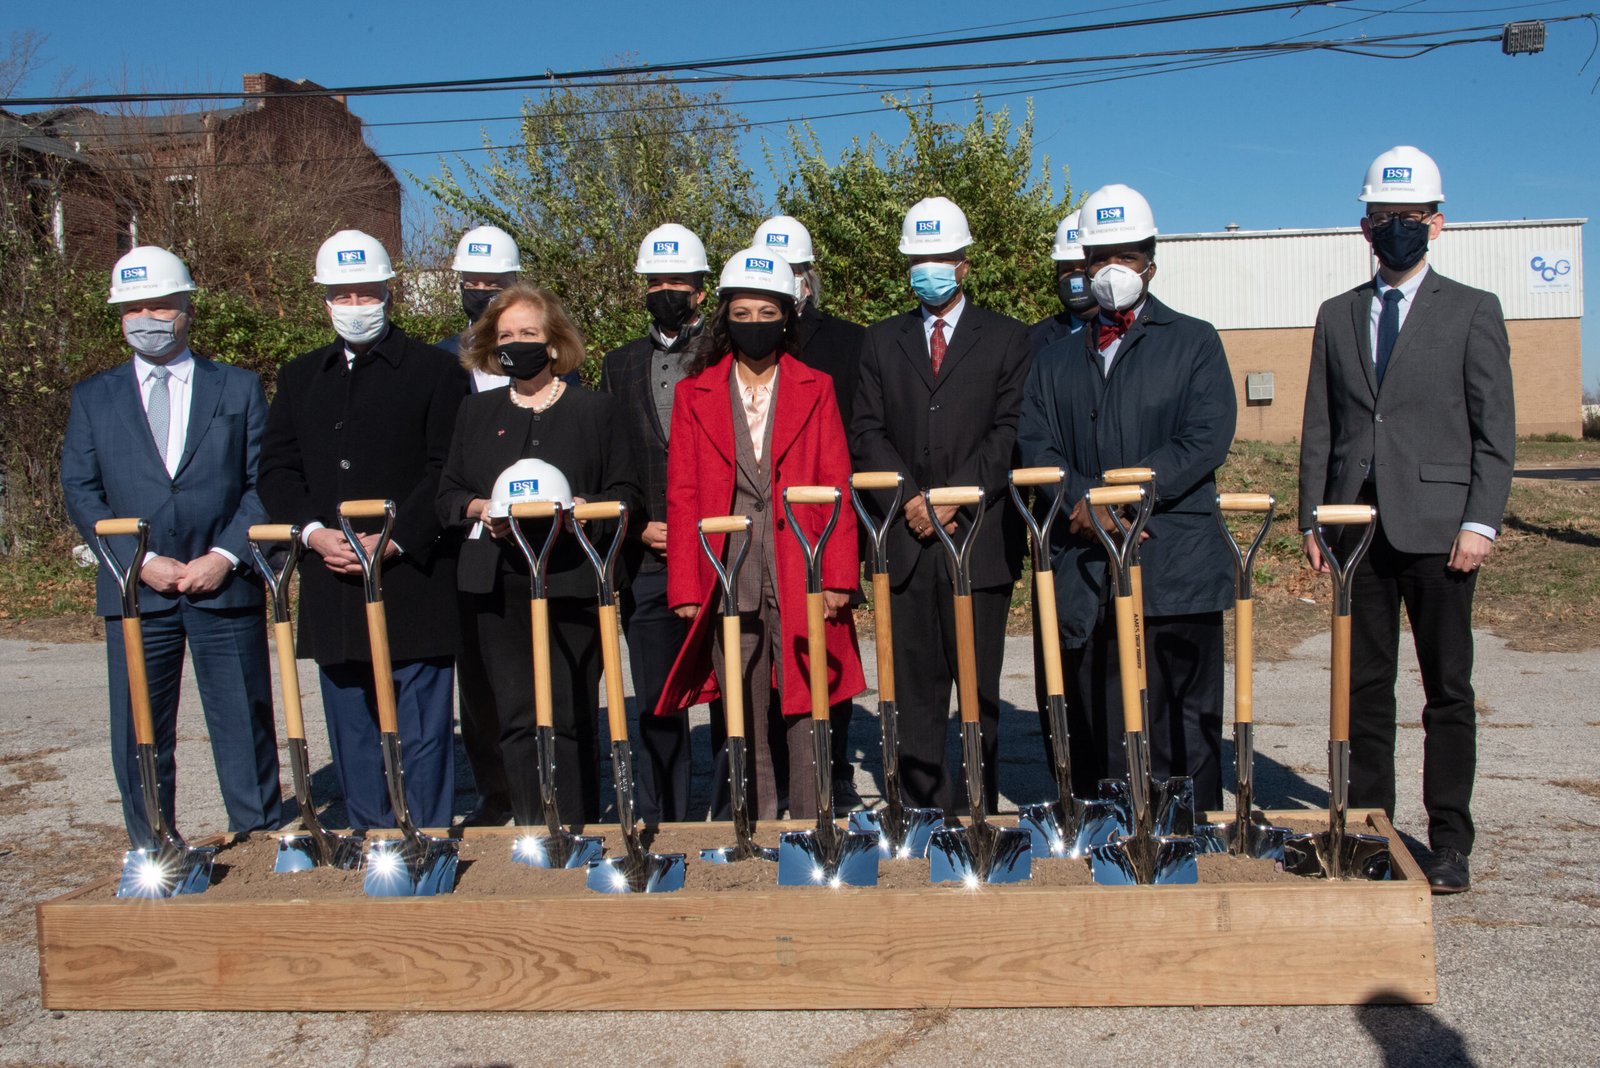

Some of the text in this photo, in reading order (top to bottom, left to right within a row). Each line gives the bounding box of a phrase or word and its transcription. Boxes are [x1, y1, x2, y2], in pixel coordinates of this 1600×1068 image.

[1386, 169, 1409, 178] BSI
[1100, 208, 1121, 219] BSI
[919, 222, 937, 231] BSI
[769, 235, 786, 243] BSI
[471, 244, 488, 252] BSI
[656, 243, 675, 251] BSI
[341, 251, 361, 261] BSI
[750, 259, 770, 269] BSI
[123, 268, 144, 279] BSI
[513, 481, 535, 492] BSI
